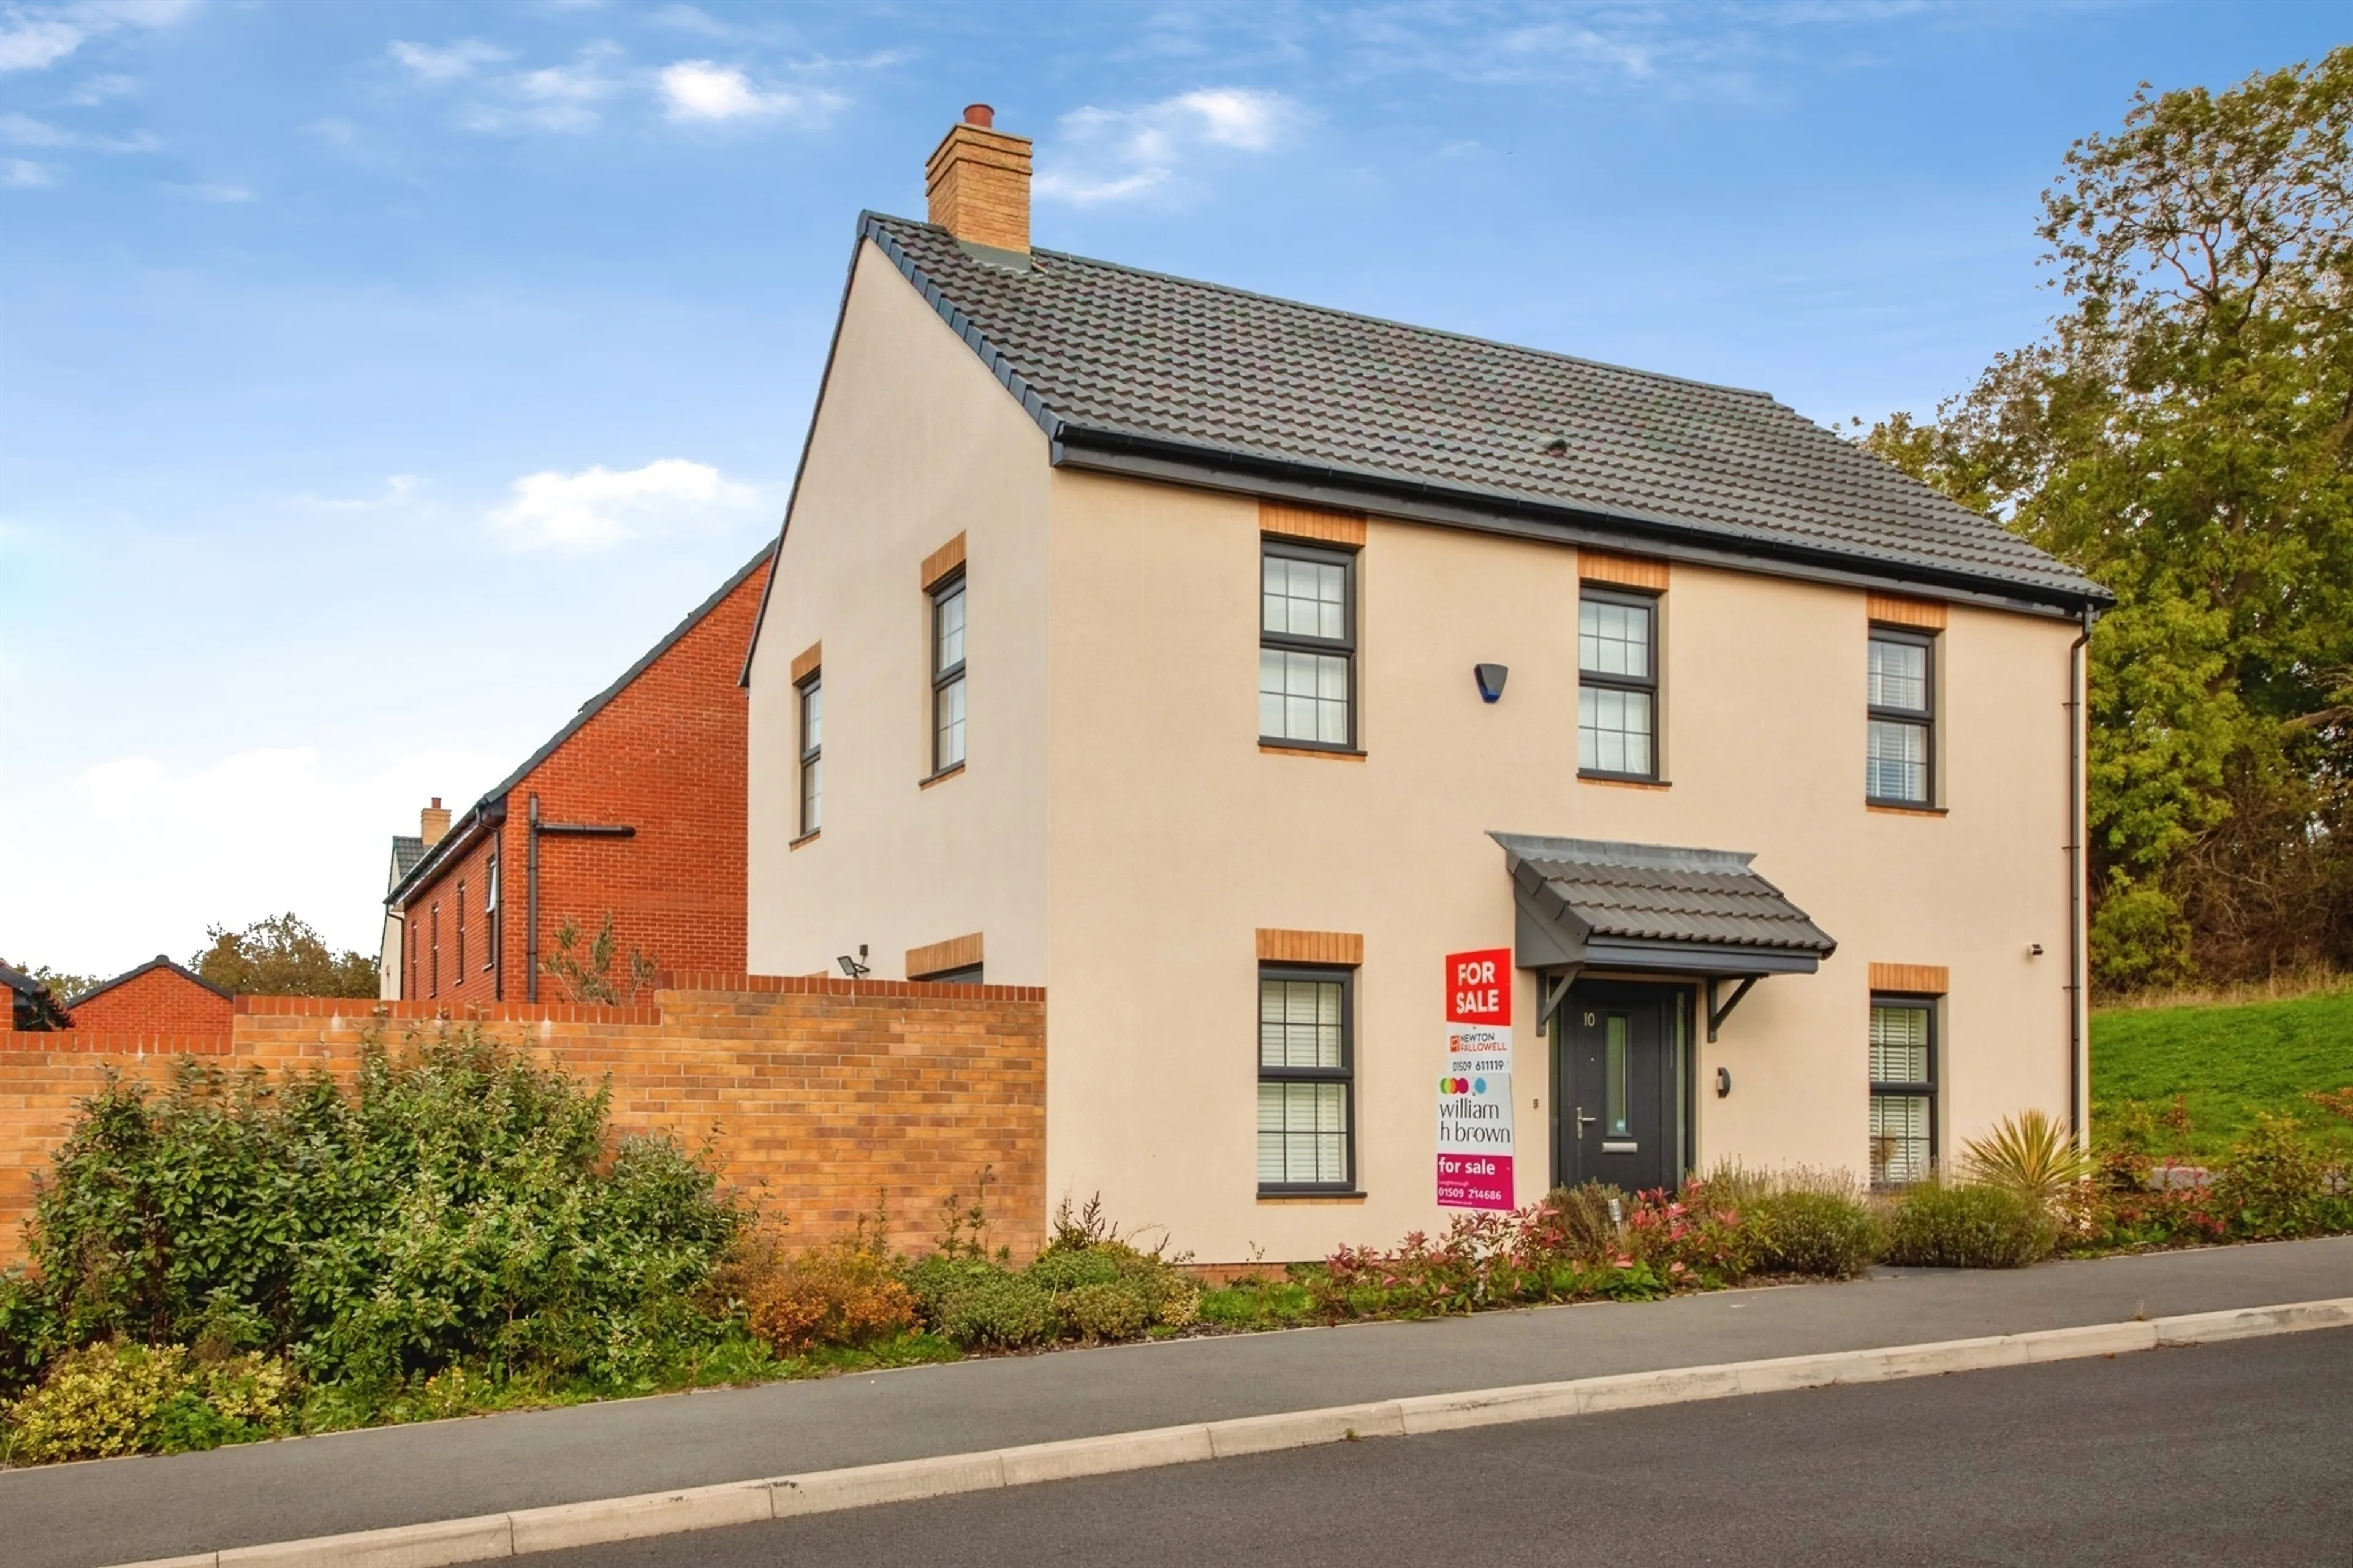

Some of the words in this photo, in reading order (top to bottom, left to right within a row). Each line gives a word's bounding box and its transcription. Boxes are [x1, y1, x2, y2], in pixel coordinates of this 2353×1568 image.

[1458, 961, 1495, 986] FOR
[1456, 989, 1499, 1014] SALE
[1584, 1012, 1595, 1027] 10
[1461, 1032, 1495, 1042] NEWTON
[1461, 1042, 1507, 1052] FALLOWELL
[1452, 1061, 1472, 1071] 01509
[1476, 1060, 1504, 1071] 611119
[1440, 1098, 1499, 1119] william
[1441, 1121, 1450, 1141] h
[1455, 1121, 1510, 1143] brown
[1439, 1157, 1461, 1173] for
[1465, 1159, 1495, 1175] sale
[1438, 1187, 1464, 1198] 01509
[1468, 1189, 1501, 1200] 214686
